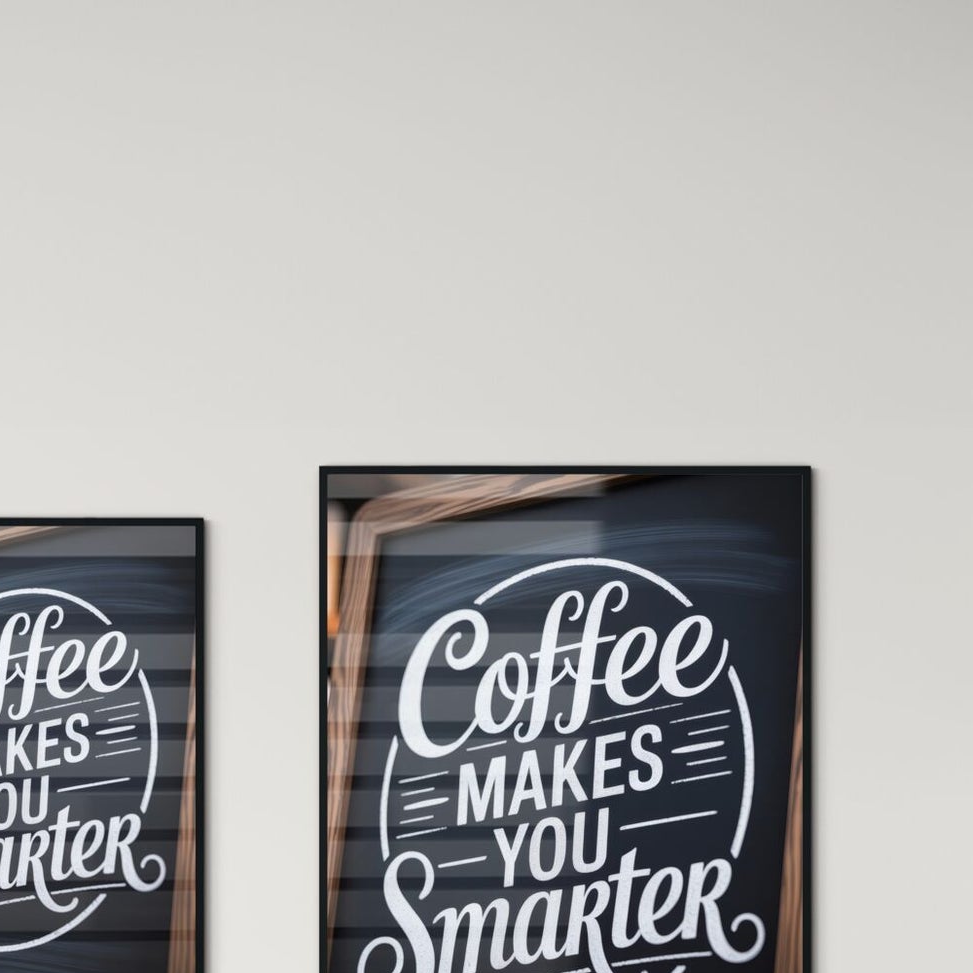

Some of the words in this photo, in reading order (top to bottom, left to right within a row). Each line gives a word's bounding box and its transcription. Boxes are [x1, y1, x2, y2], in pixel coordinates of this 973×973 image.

[398, 581, 729, 758] Coffee
[456, 724, 664, 827] MAKES
[493, 808, 610, 888] YOU
